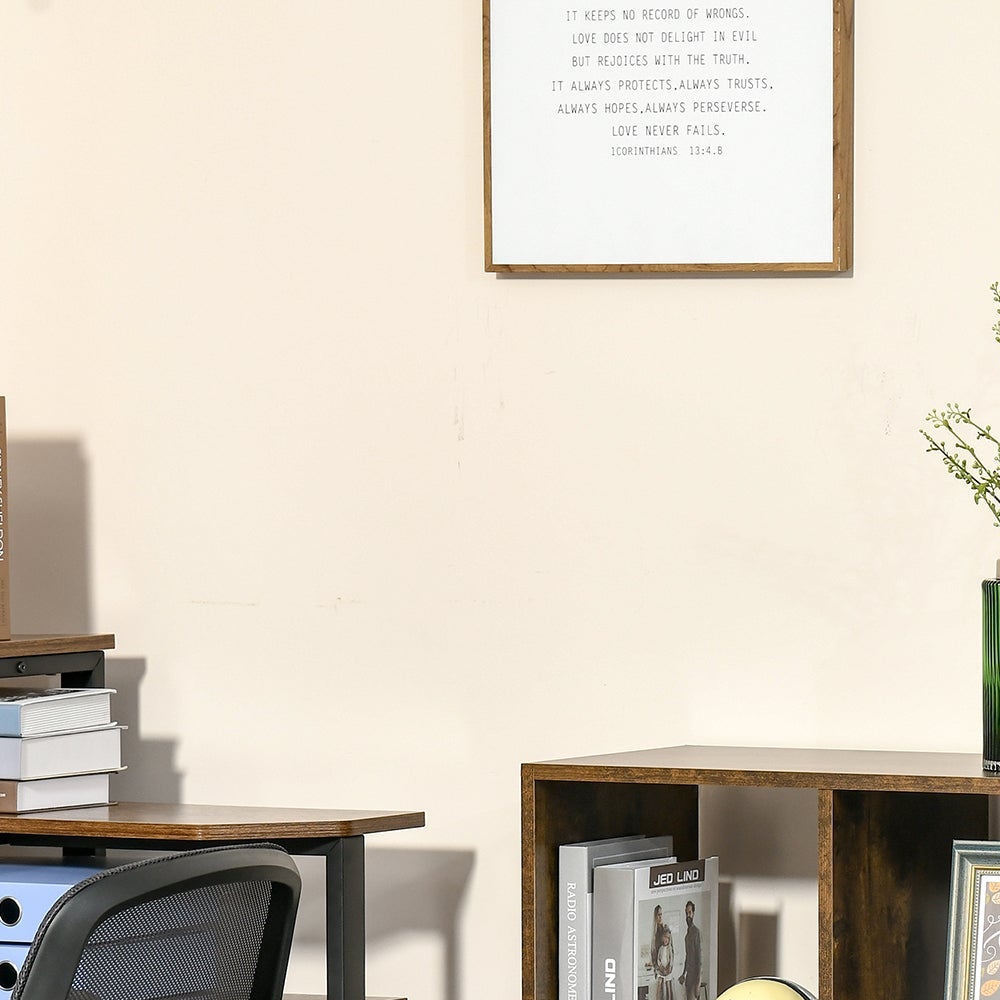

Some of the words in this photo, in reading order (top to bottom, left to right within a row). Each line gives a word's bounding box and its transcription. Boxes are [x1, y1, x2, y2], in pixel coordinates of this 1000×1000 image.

[567, 11, 577, 21] IT
[585, 10, 616, 21] KEEPS
[623, 9, 635, 20] NO
[642, 9, 680, 20] RECORD
[687, 8, 699, 19] OF
[706, 8, 749, 18] WRONGS.
[573, 33, 596, 44] LOVE
[604, 32, 628, 43] DOES
[636, 32, 654, 43] NOT
[662, 31, 705, 42] DELIGHT
[714, 31, 725, 41] IN
[733, 30, 757, 41] EVIL
[572, 56, 590, 67] BUT
[598, 55, 648, 66] REJOICES
[655, 55, 680, 65] WITH
[687, 54, 705, 65] THE
[713, 54, 749, 65] TRUTH.
[552, 81, 563, 91] IT
[571, 80, 611, 91] ALWAYS
[558, 103, 597, 114] ALWAYS
[694, 101, 765, 112] PERSEVERSE.
[613, 125, 637, 136] LOVE
[646, 125, 679, 136] NEVER
[687, 125, 725, 135] FAILS.
[653, 873, 673, 886] JED
[677, 869, 699, 882] LIND
[567, 882, 577, 921] RADIO
